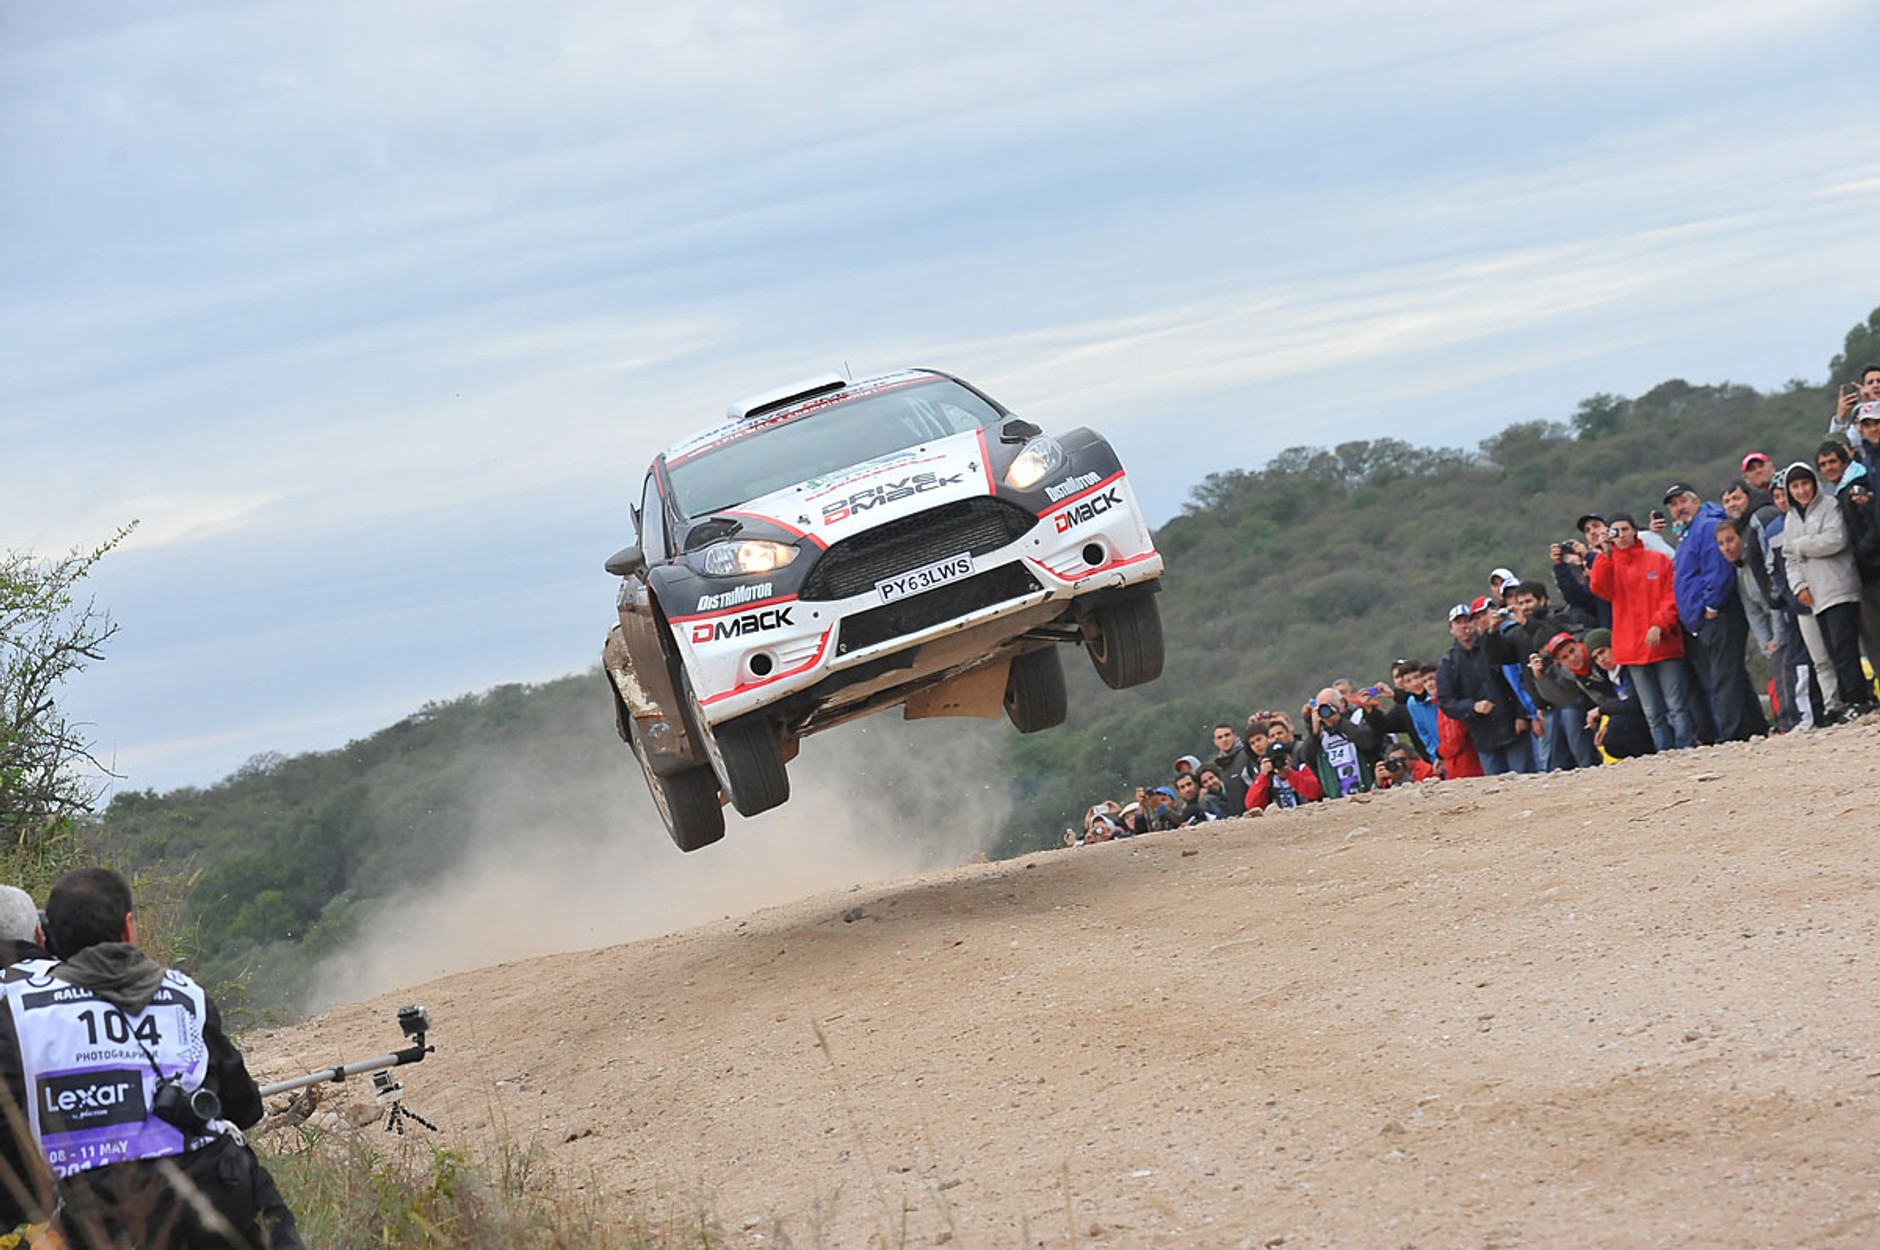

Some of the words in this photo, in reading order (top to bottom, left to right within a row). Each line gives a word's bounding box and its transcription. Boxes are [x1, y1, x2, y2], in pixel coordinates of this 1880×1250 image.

[821, 472, 937, 515] DRIVE
[823, 473, 964, 526] DMACK
[1054, 487, 1123, 534] DMACK
[881, 559, 970, 600] PY63LWS
[692, 606, 795, 644] DMACK
[77, 1009, 162, 1046] 104
[75, 1050, 159, 1062] PHOTOGRAPHR
[45, 1082, 129, 1112] Lexar
[100, 1141, 128, 1156] MAY
